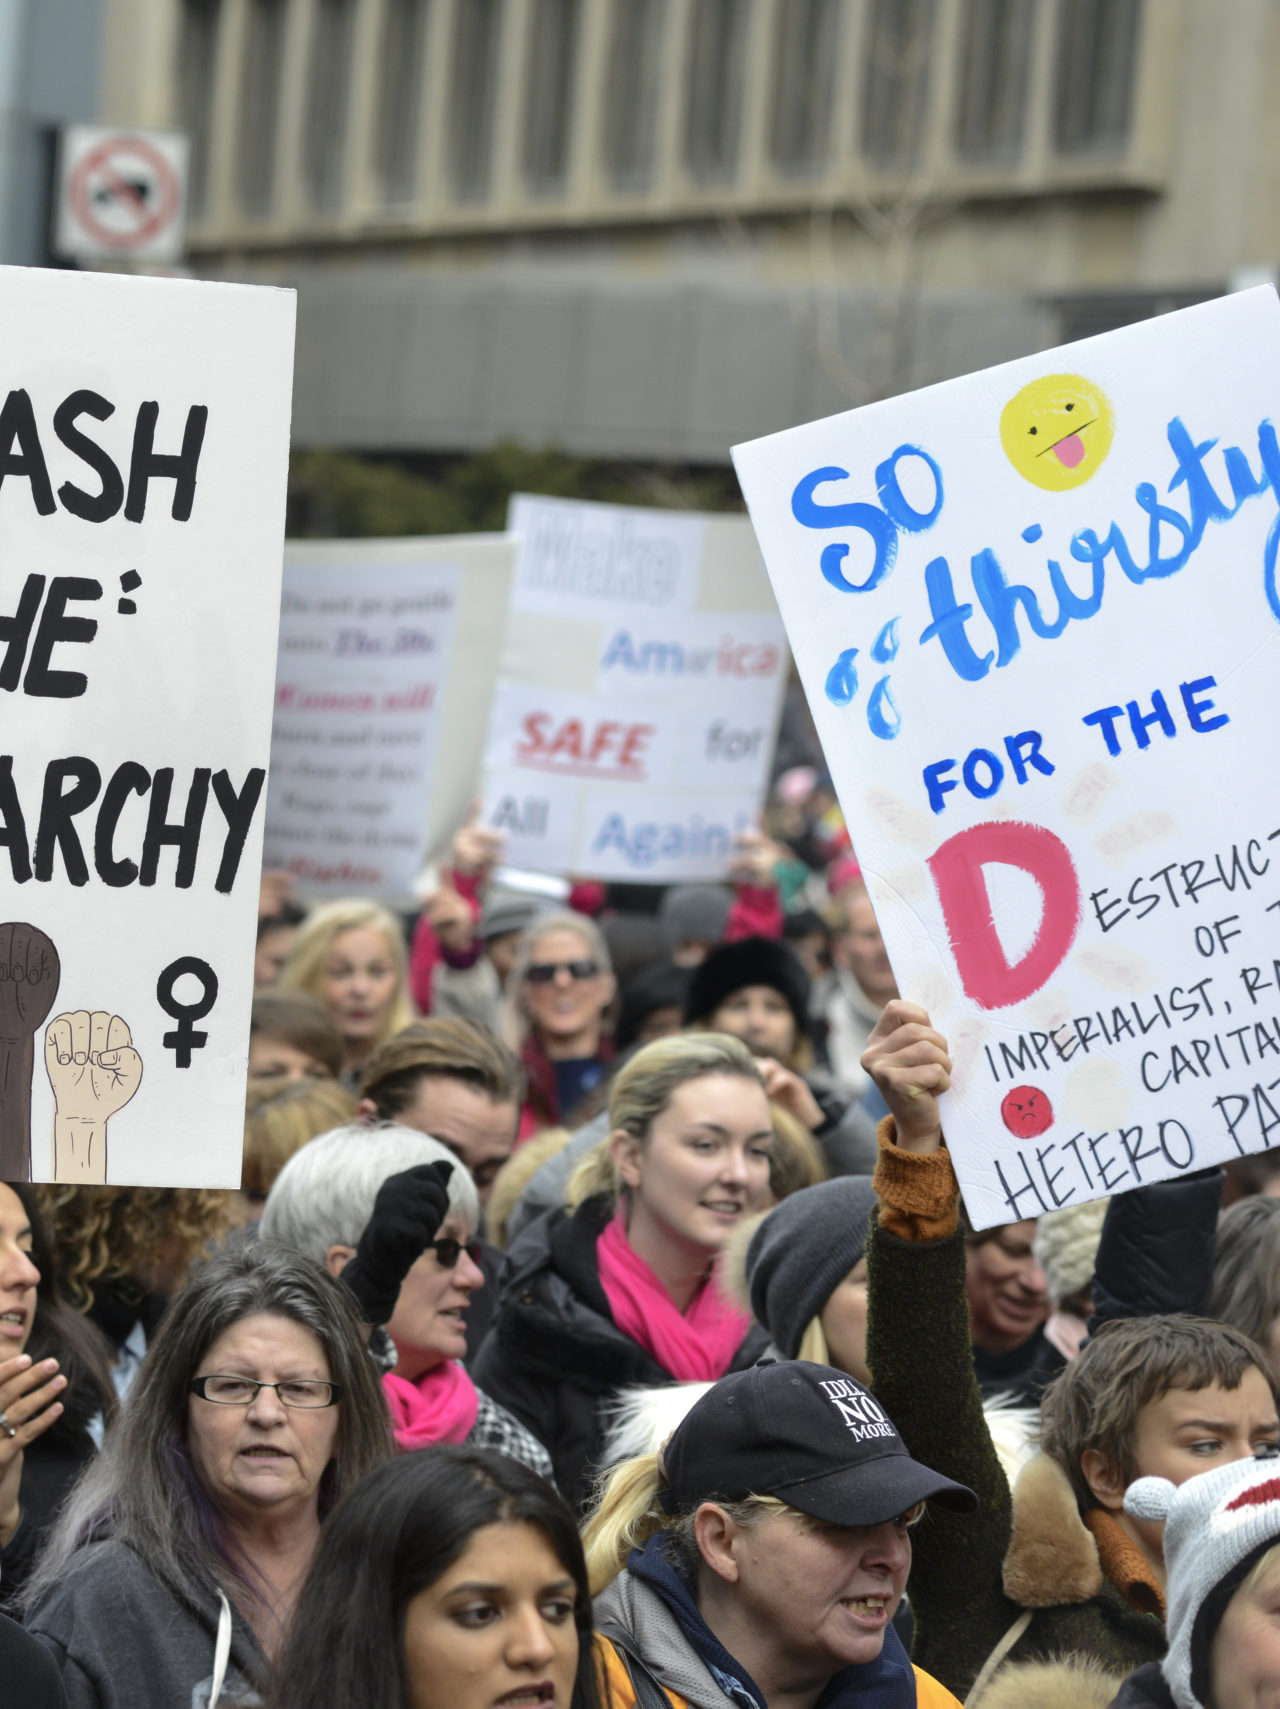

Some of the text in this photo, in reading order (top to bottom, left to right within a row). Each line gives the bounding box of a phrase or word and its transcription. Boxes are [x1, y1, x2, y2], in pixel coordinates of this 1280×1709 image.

[523, 505, 683, 606] Make
[791, 443, 944, 593] So
[920, 415, 1280, 681] thirsty
[516, 709, 764, 772] SAFE for
[923, 675, 1230, 814] FOR THE
[490, 794, 550, 838] All
[1195, 914, 1242, 958] OF
[984, 977, 1232, 1082] IMPERIALIST,
[993, 1078, 1280, 1220] HETERO PA
[831, 1396, 885, 1427] NO
[849, 1423, 896, 1443] MORE
